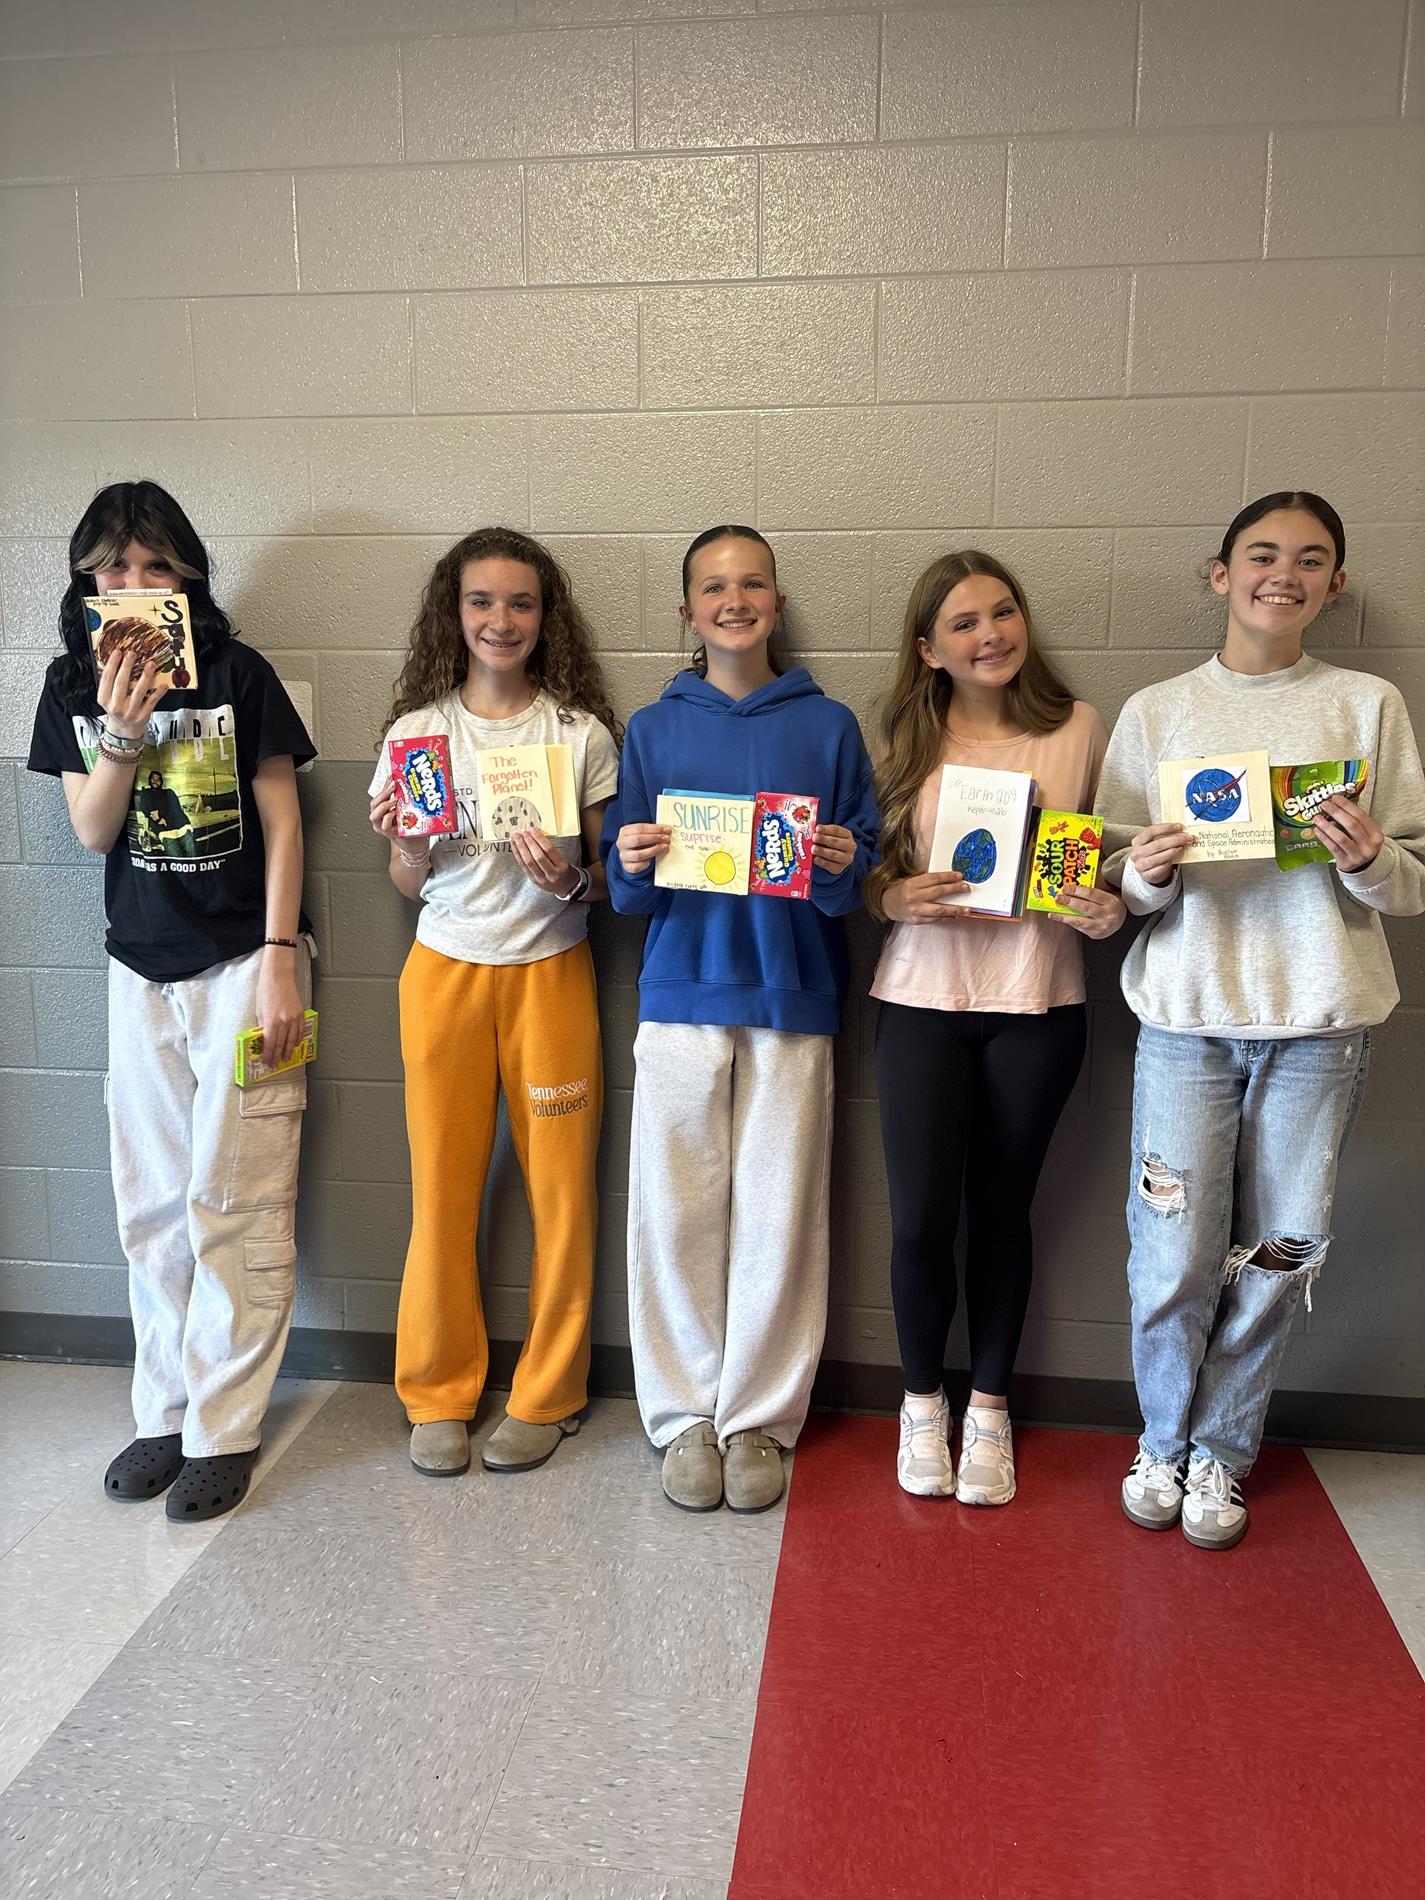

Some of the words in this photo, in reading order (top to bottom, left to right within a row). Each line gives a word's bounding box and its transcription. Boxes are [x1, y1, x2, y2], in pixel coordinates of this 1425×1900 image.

[490, 756, 518, 769] The
[481, 769, 539, 785] Forgotten
[491, 779, 533, 795] Planet!
[1191, 788, 1240, 804] NASA
[1283, 782, 1356, 817] Skittles
[673, 802, 750, 834] SUNRISE
[1198, 830, 1229, 840] National
[1207, 840, 1228, 850] Space
[160, 862, 168, 872] A
[170, 862, 197, 873] GOOD
[1048, 841, 1065, 885] SOUR
[1062, 839, 1079, 886] PATCH
[525, 1078, 589, 1100] Tennessee
[529, 1094, 589, 1117] Volunteers
